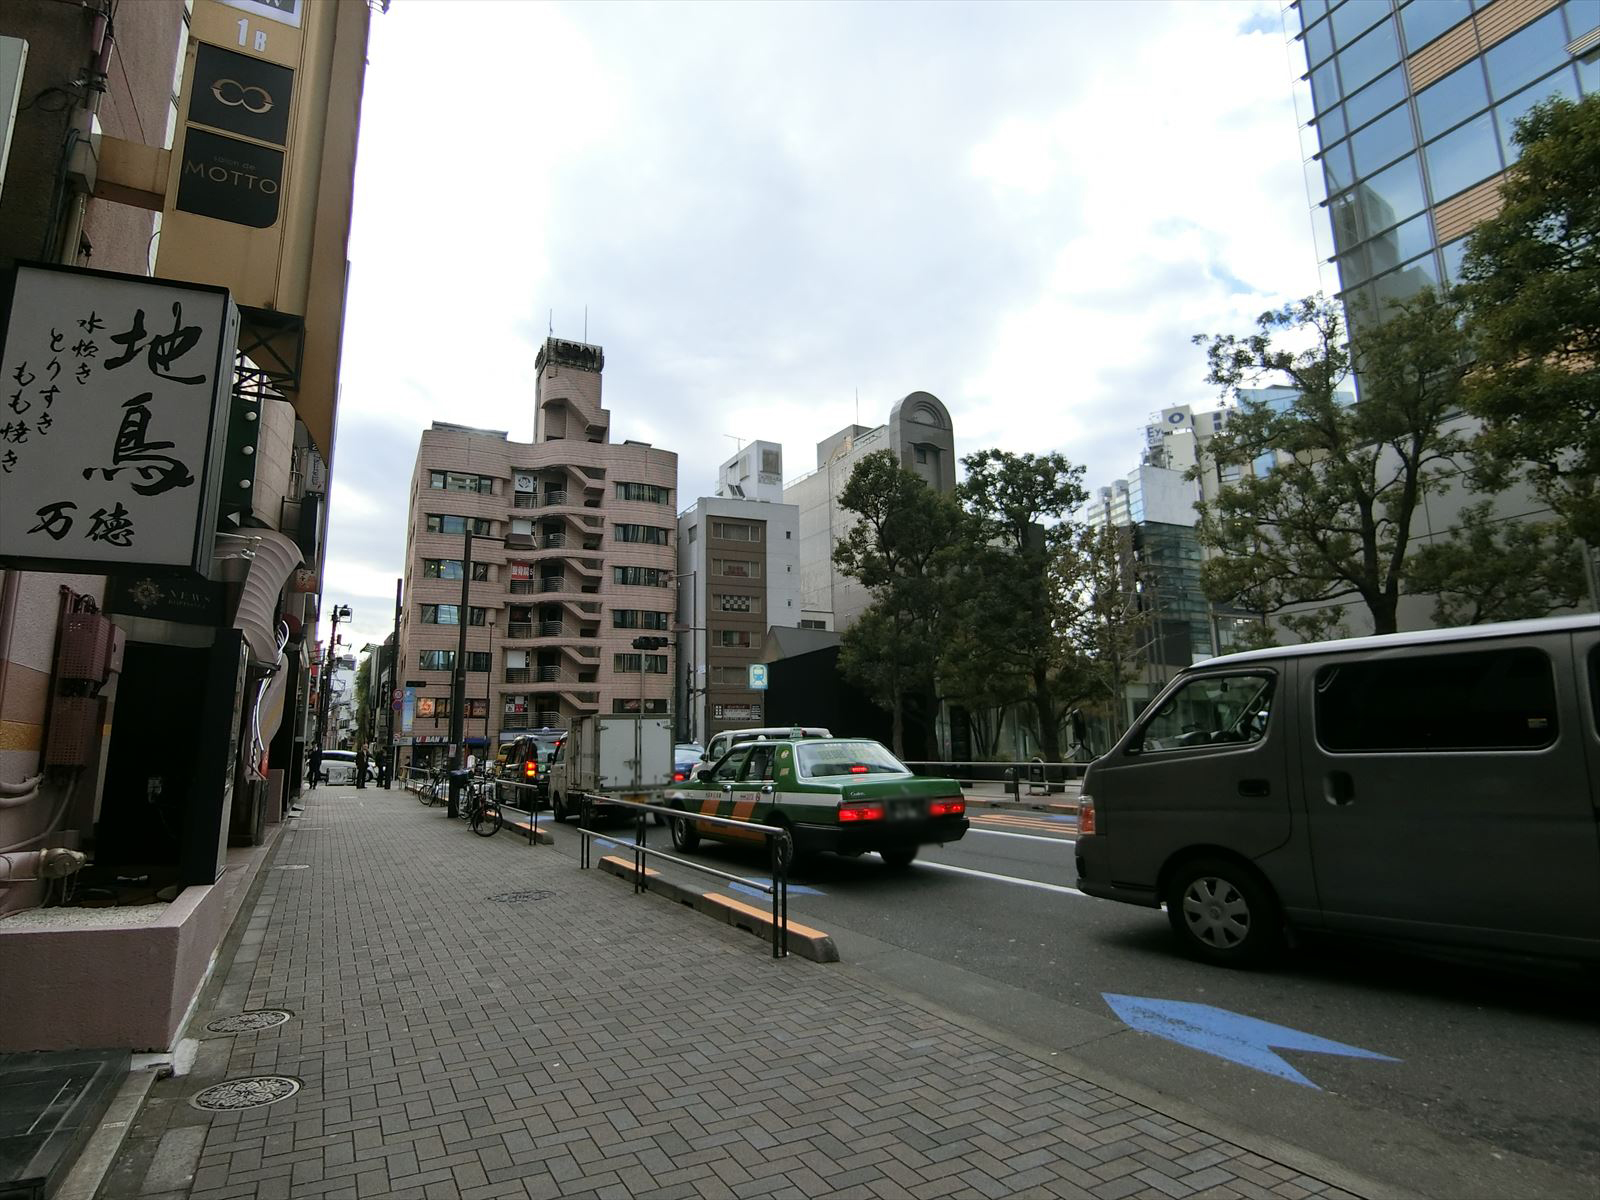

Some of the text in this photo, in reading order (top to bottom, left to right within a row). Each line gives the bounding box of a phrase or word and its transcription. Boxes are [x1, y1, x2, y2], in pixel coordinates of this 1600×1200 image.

[184, 160, 278, 194] MOTTO
[36, 327, 65, 436] とりすき
[72, 311, 107, 385] 水炊き
[0, 361, 36, 473] もも焼き
[27, 501, 135, 547] 万徳
